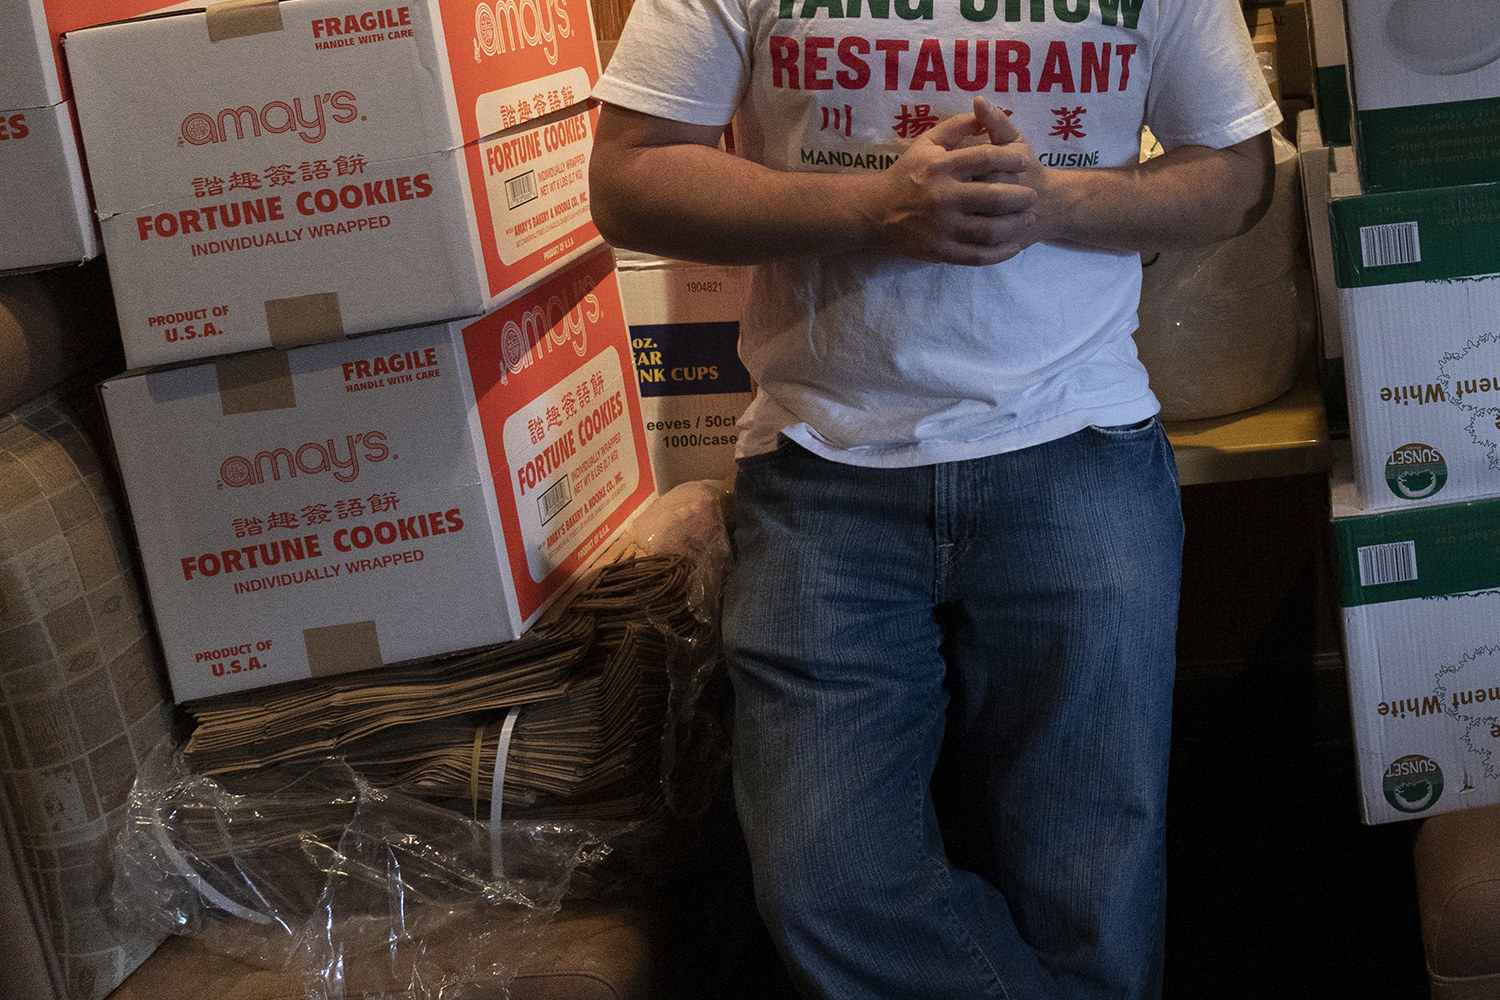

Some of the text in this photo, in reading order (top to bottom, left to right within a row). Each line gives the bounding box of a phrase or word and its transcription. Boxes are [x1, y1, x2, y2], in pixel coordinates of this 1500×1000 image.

[311, 6, 412, 39] FRAGILE
[769, 35, 1138, 94] RESTAURANT
[820, 104, 1088, 142] 川揚菜
[800, 147, 1100, 171] MANDARIN CUISINE
[137, 173, 434, 242] FORTUNE COOKIES
[191, 215, 391, 258] INDIVIDUALLY WRAPPED
[687, 281, 723, 293] 1904821
[341, 348, 438, 382] FRAGILE
[671, 366, 719, 382] CUPS
[1379, 383, 1447, 404] White
[705, 416, 737, 428] 50ct
[663, 434, 737, 448] 1000/case
[181, 508, 465, 581] FORTUNE COOKIES
[195, 640, 273, 664] PRODUCT OF
[211, 656, 268, 678] U.S.A.
